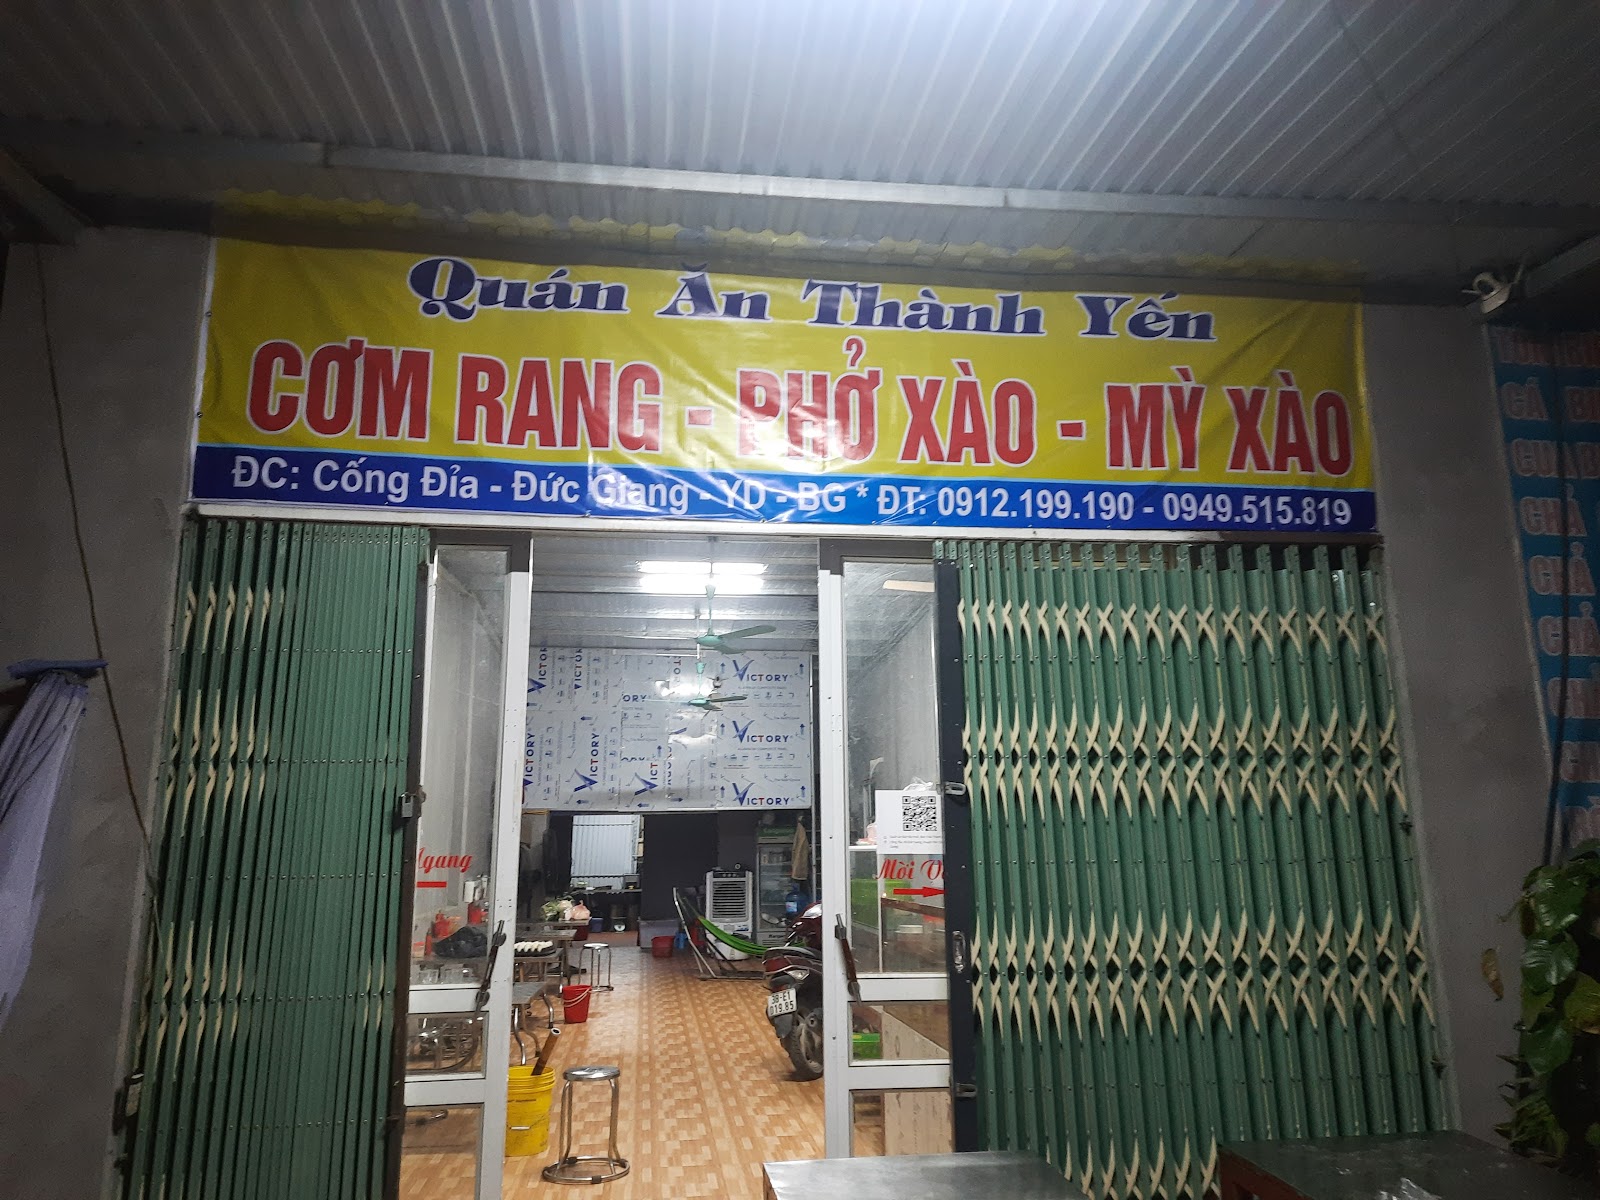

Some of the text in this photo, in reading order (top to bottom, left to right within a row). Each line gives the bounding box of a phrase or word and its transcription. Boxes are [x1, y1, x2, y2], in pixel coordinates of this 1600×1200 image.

[408, 256, 1217, 342] Quán Ăn Thành Yến
[247, 335, 1353, 477] CƠM RANG - PHỞ XÀO - MỲ XÀO
[231, 455, 299, 490] ĐC:
[313, 457, 409, 503] Cống
[420, 464, 478, 498] Đỉa
[490, 485, 502, 493] -
[511, 469, 580, 503] Đức
[590, 471, 690, 515] Giang
[720, 479, 768, 510] YD
[800, 482, 847, 513] BG
[877, 486, 927, 516] ĐT:
[937, 487, 1135, 521] 0912.199.190
[1143, 506, 1155, 514] -
[1162, 492, 1352, 526] 0949.515.819
[732, 659, 789, 681] VICTORY
[622, 694, 647, 703] ORY
[732, 719, 790, 743] VICTORY
[574, 732, 600, 792] VICTORY
[634, 762, 659, 796] VICT
[732, 782, 791, 806] VICTORY
[920, 859, 944, 880] V
